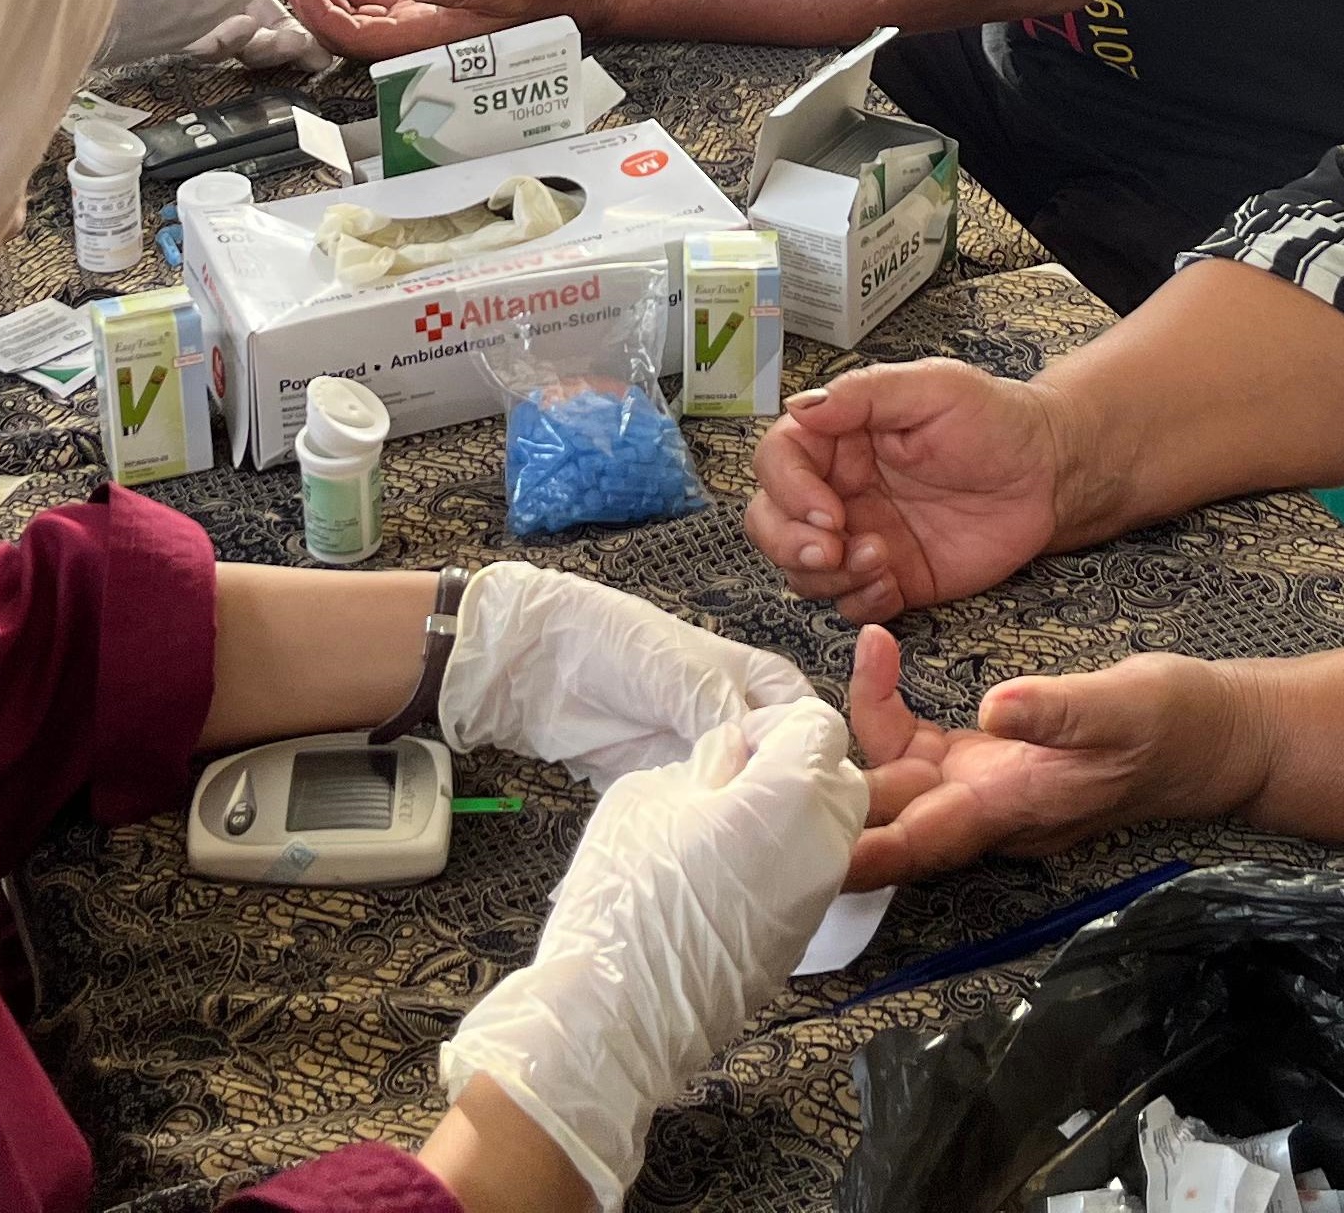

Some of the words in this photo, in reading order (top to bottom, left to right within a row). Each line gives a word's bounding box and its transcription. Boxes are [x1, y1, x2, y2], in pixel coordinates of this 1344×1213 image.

[456, 43, 486, 57] PASS
[460, 55, 488, 74] QC
[473, 75, 570, 115] SWABS
[508, 97, 570, 122] ALCOHOL
[860, 233, 901, 274] ALCOHOL
[860, 230, 921, 298] SWABS
[459, 274, 602, 330] Altamed
[390, 329, 507, 369] Ambidextrous
[528, 304, 622, 338] Non-Sterile
